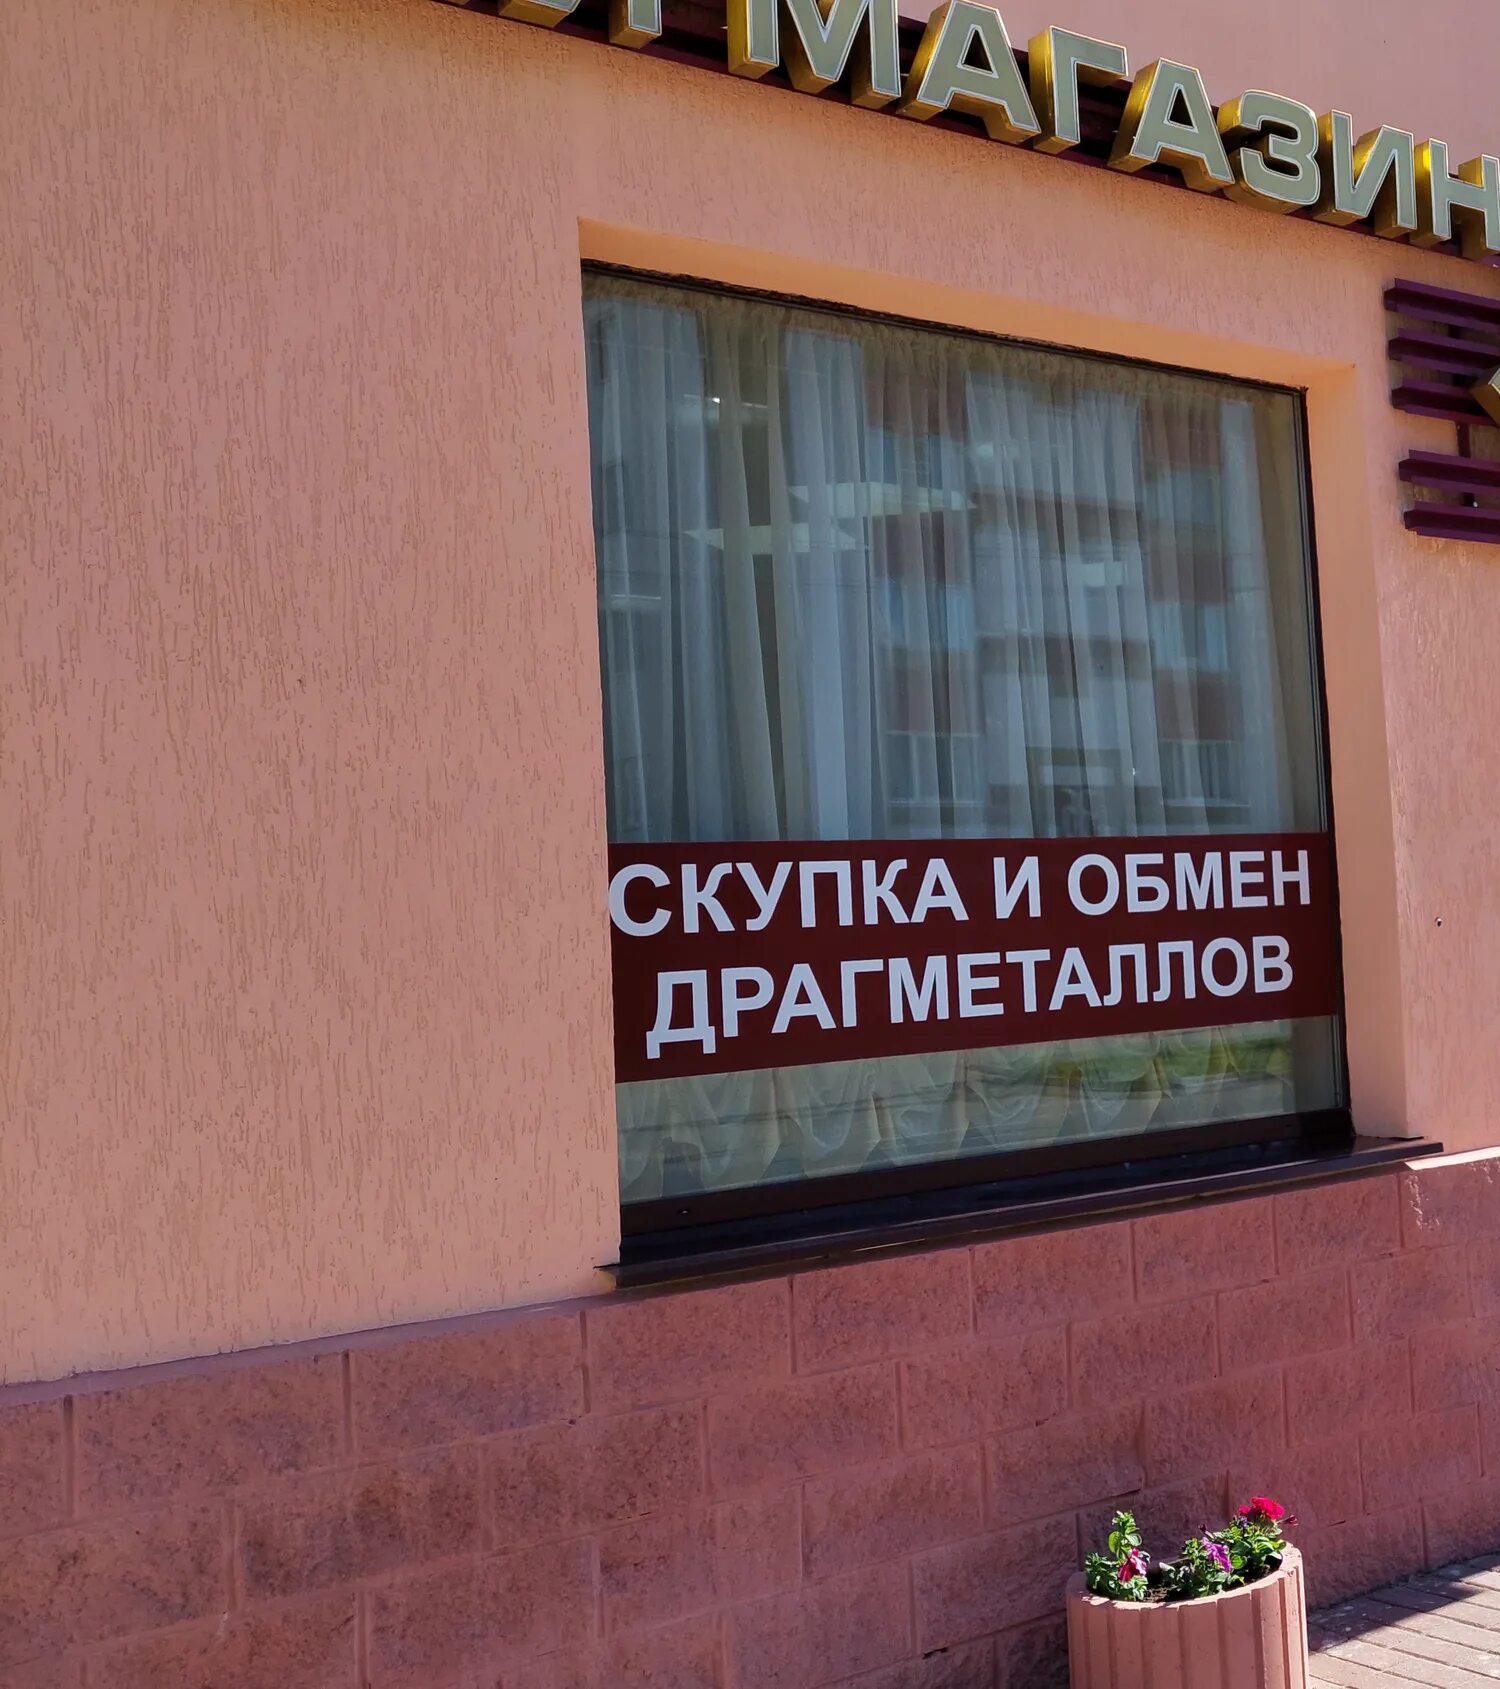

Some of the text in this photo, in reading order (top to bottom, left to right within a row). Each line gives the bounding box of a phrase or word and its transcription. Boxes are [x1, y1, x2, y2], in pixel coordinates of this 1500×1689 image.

[609, 850, 1311, 936] СКУПКА И ОБМЕН
[646, 935, 1293, 1059] ДРАГМЕТАЛЛОВ
